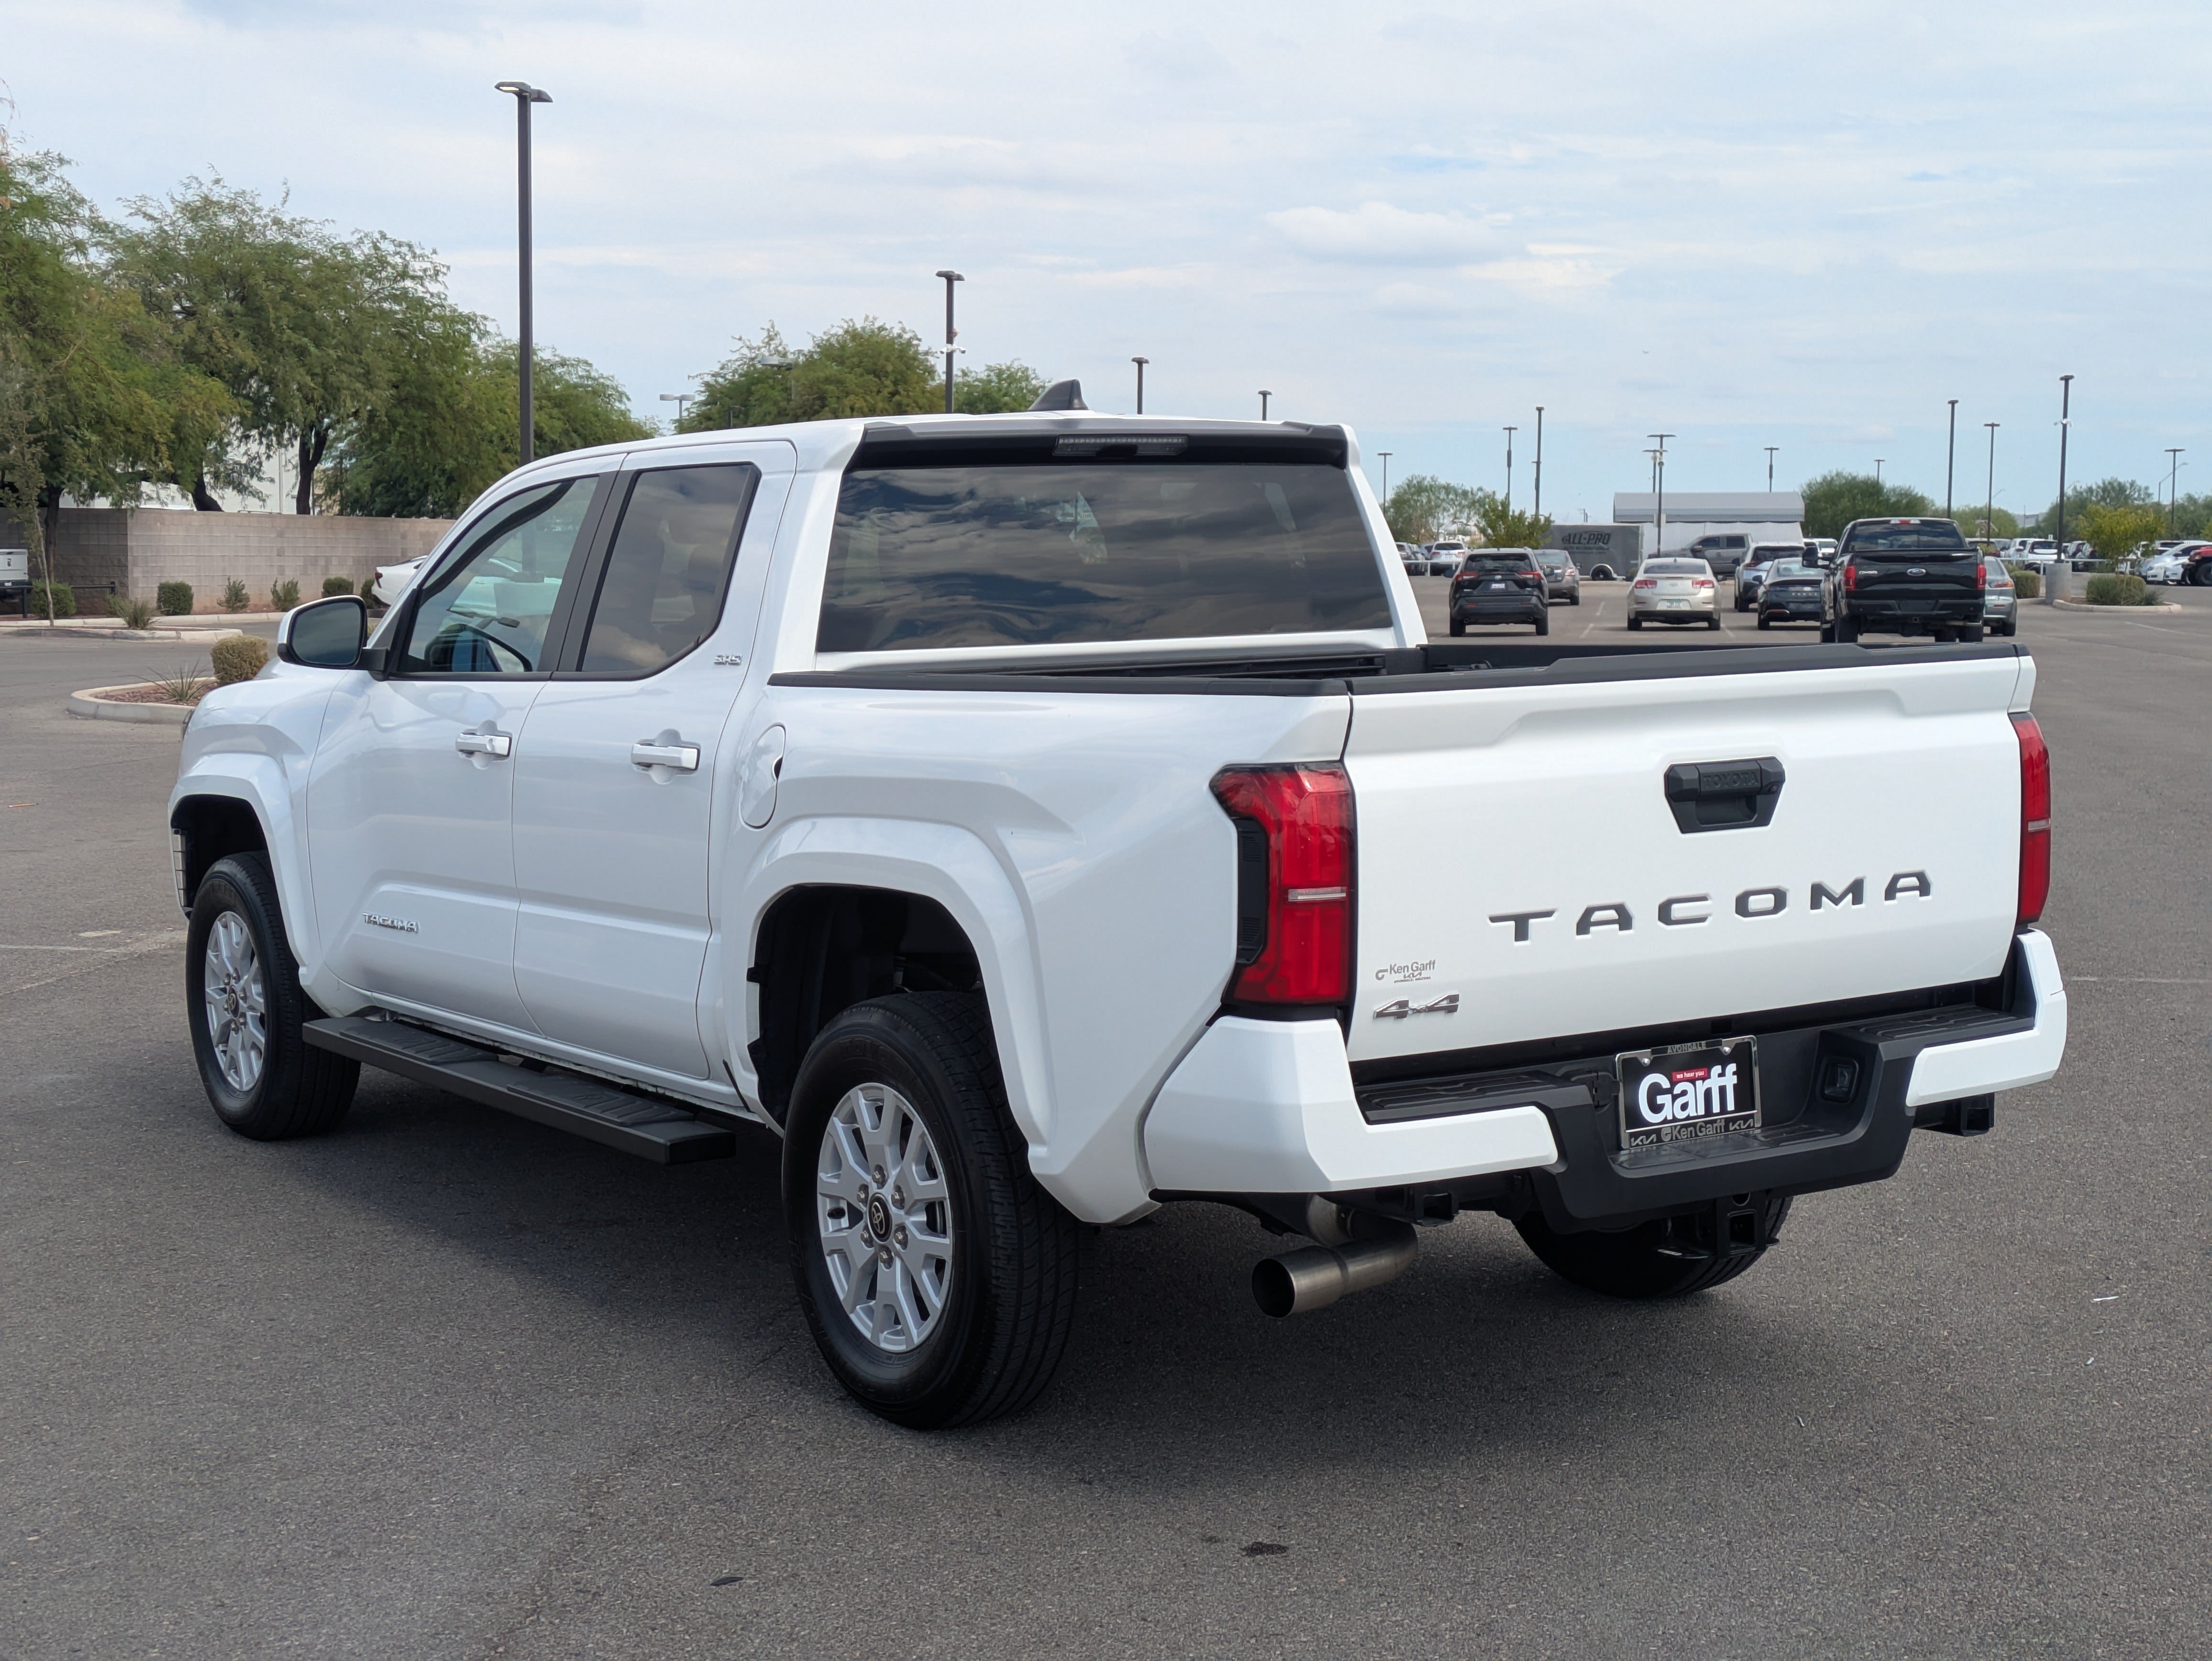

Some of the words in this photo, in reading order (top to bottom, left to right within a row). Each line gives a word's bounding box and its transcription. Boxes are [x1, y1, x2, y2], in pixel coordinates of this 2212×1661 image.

[1561, 532, 1611, 544] ALL-PRO
[714, 654, 742, 665] SR5
[1703, 771, 1759, 788] TOYOTA
[1488, 869, 1932, 942] TACOMA
[363, 912, 420, 933] TACOMA
[1389, 963, 1409, 974] Ken
[1411, 959, 1436, 972] Garff
[1667, 1041, 1706, 1054] AVONDALE
[1638, 1063, 1737, 1123] Garff
[1672, 1125, 1695, 1140] Ken
[1696, 1118, 1725, 1136] Garff
